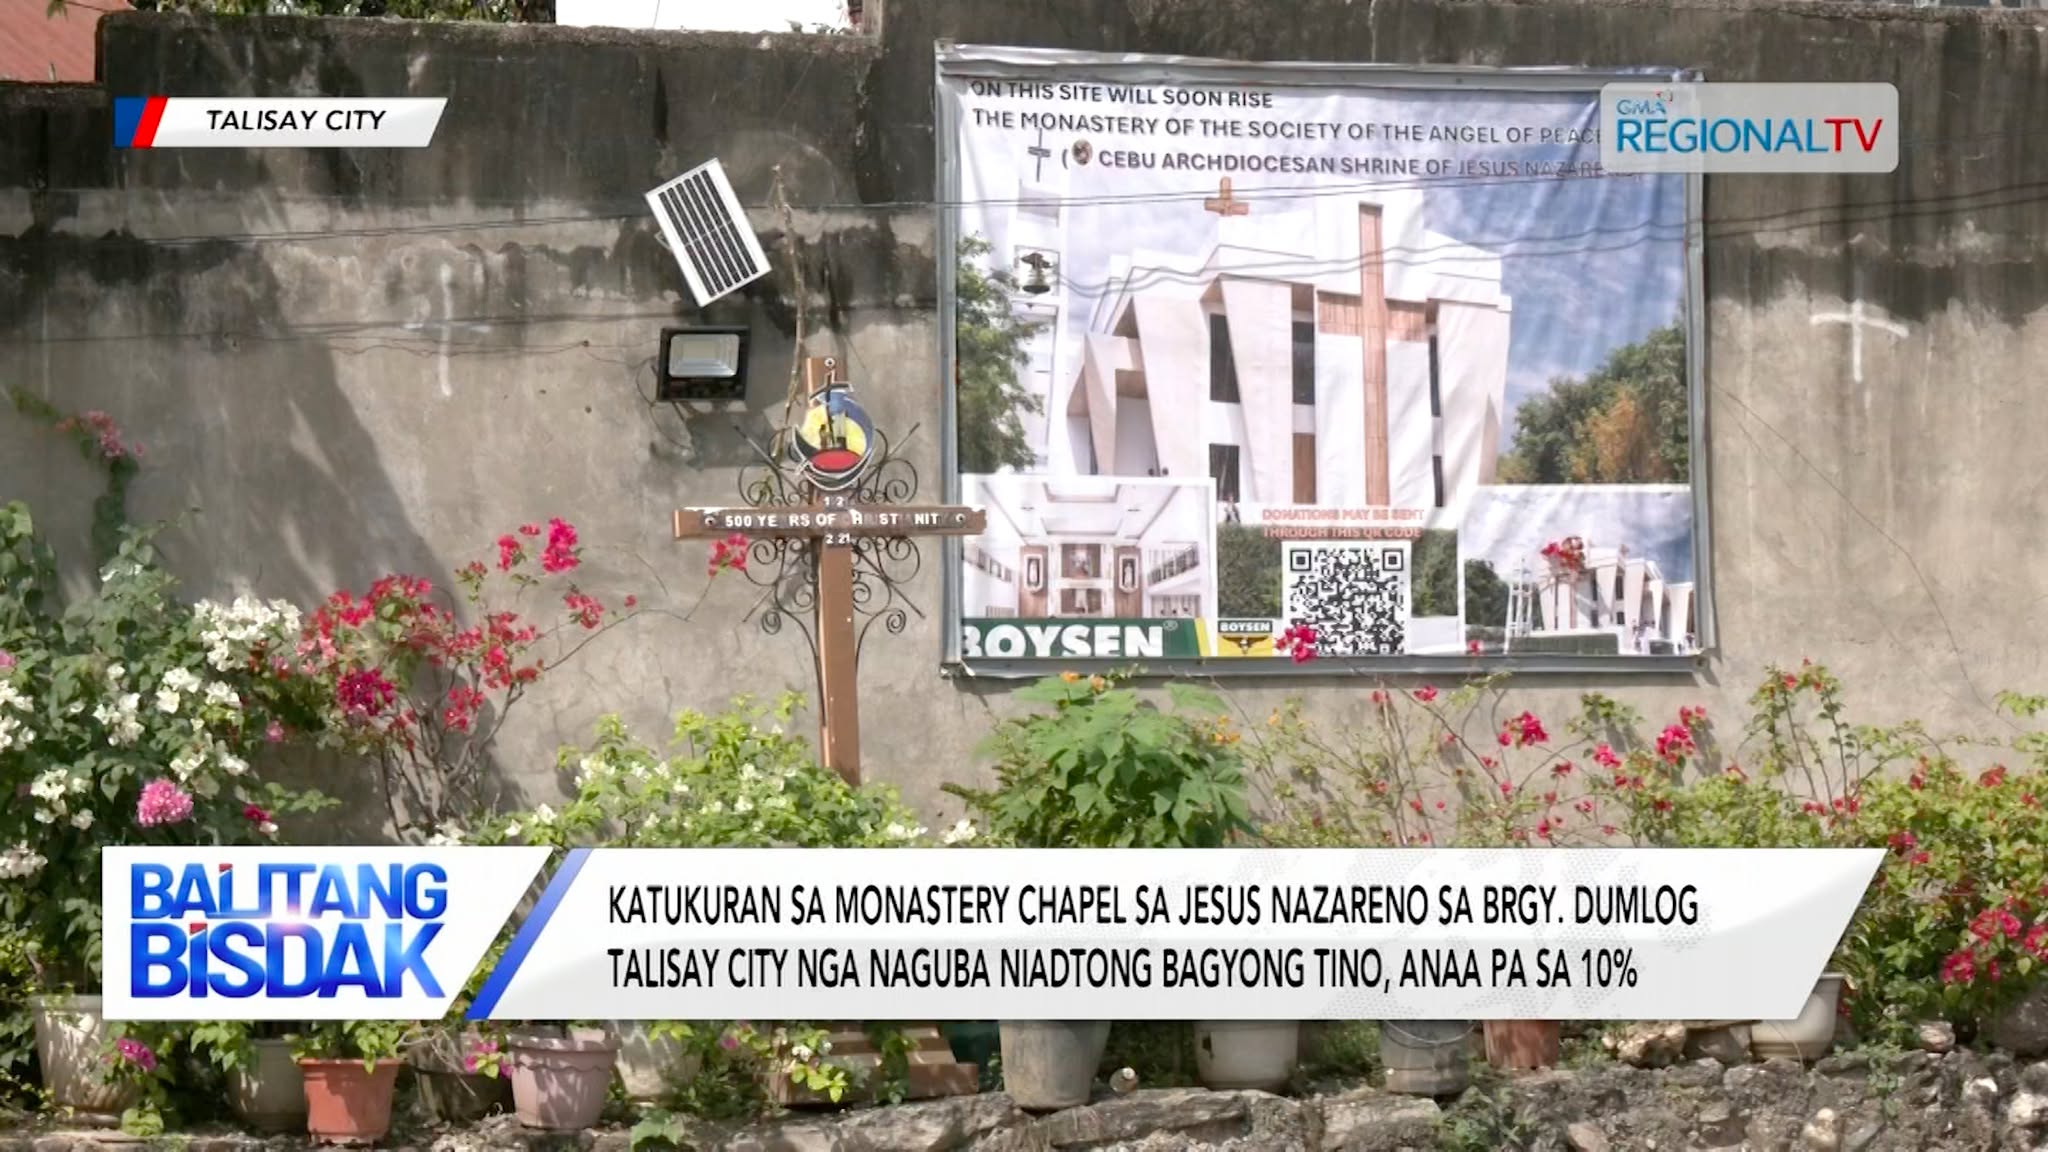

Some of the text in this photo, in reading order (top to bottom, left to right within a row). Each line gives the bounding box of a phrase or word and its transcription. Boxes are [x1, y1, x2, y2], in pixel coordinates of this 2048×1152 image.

[971, 80, 1274, 109] ON THIS SITE WILL SOON RISE
[973, 108, 1014, 128] THE
[1020, 112, 1159, 135] MONASTERY
[1165, 118, 1194, 136] OF
[1200, 119, 1242, 138] THE
[1248, 120, 1344, 140] SOCIETY
[1347, 123, 1376, 141] OF
[1383, 124, 1425, 142] THE
[1429, 125, 1500, 143] ANGEL
[1506, 126, 1534, 143] OF
[1099, 150, 1156, 169] CEBU
[1162, 152, 1334, 174] ARCHDIOCESAN
[1341, 156, 1420, 175] SHRINE
[1426, 159, 1452, 176] OF
[1458, 160, 1518, 177] JESUS
[725, 514, 752, 527] 500
[757, 513, 811, 527] YERS
[815, 512, 838, 527] OF
[1342, 509, 1370, 521] MAY
[1373, 509, 1389, 521] BE
[1392, 509, 1424, 521] SENT
[1263, 527, 1423, 539] THROUGH THIS QR CODE
[1220, 621, 1271, 633] BOYSEN
